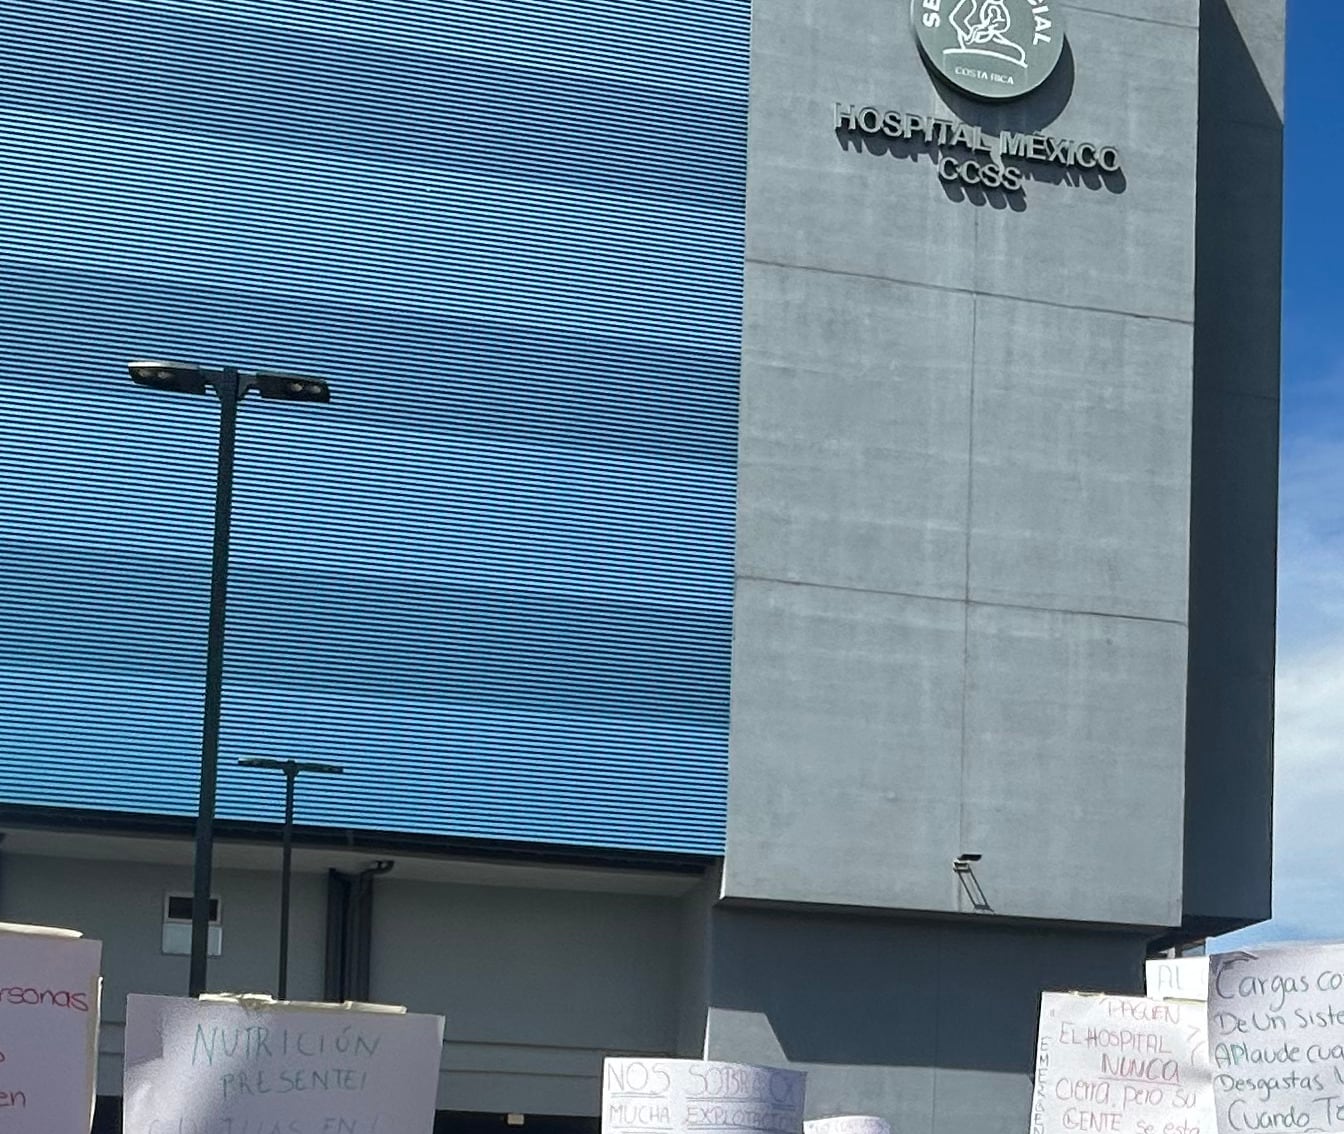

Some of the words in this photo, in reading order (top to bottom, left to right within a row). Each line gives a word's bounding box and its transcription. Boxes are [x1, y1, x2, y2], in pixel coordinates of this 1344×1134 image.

[955, 66, 988, 80] COSTA
[990, 74, 1014, 85] RICA
[834, 102, 997, 151] HOSPITAL
[939, 155, 1022, 191] CCSS
[1215, 954, 1309, 1012] Cargas
[1059, 1022, 1081, 1045] EL
[1085, 1027, 1172, 1054] HOSPITAL
[1214, 1010, 1248, 1035] De
[191, 1023, 382, 1066] NUTRICIÓN
[607, 1062, 670, 1094] NOS
[1214, 1072, 1324, 1100] Desgastas
[1123, 1084, 1162, 1109] pero
[609, 1105, 670, 1124] MUCHA
[1063, 1108, 1123, 1132] GENTE
[1228, 1099, 1310, 1132] Cuando
